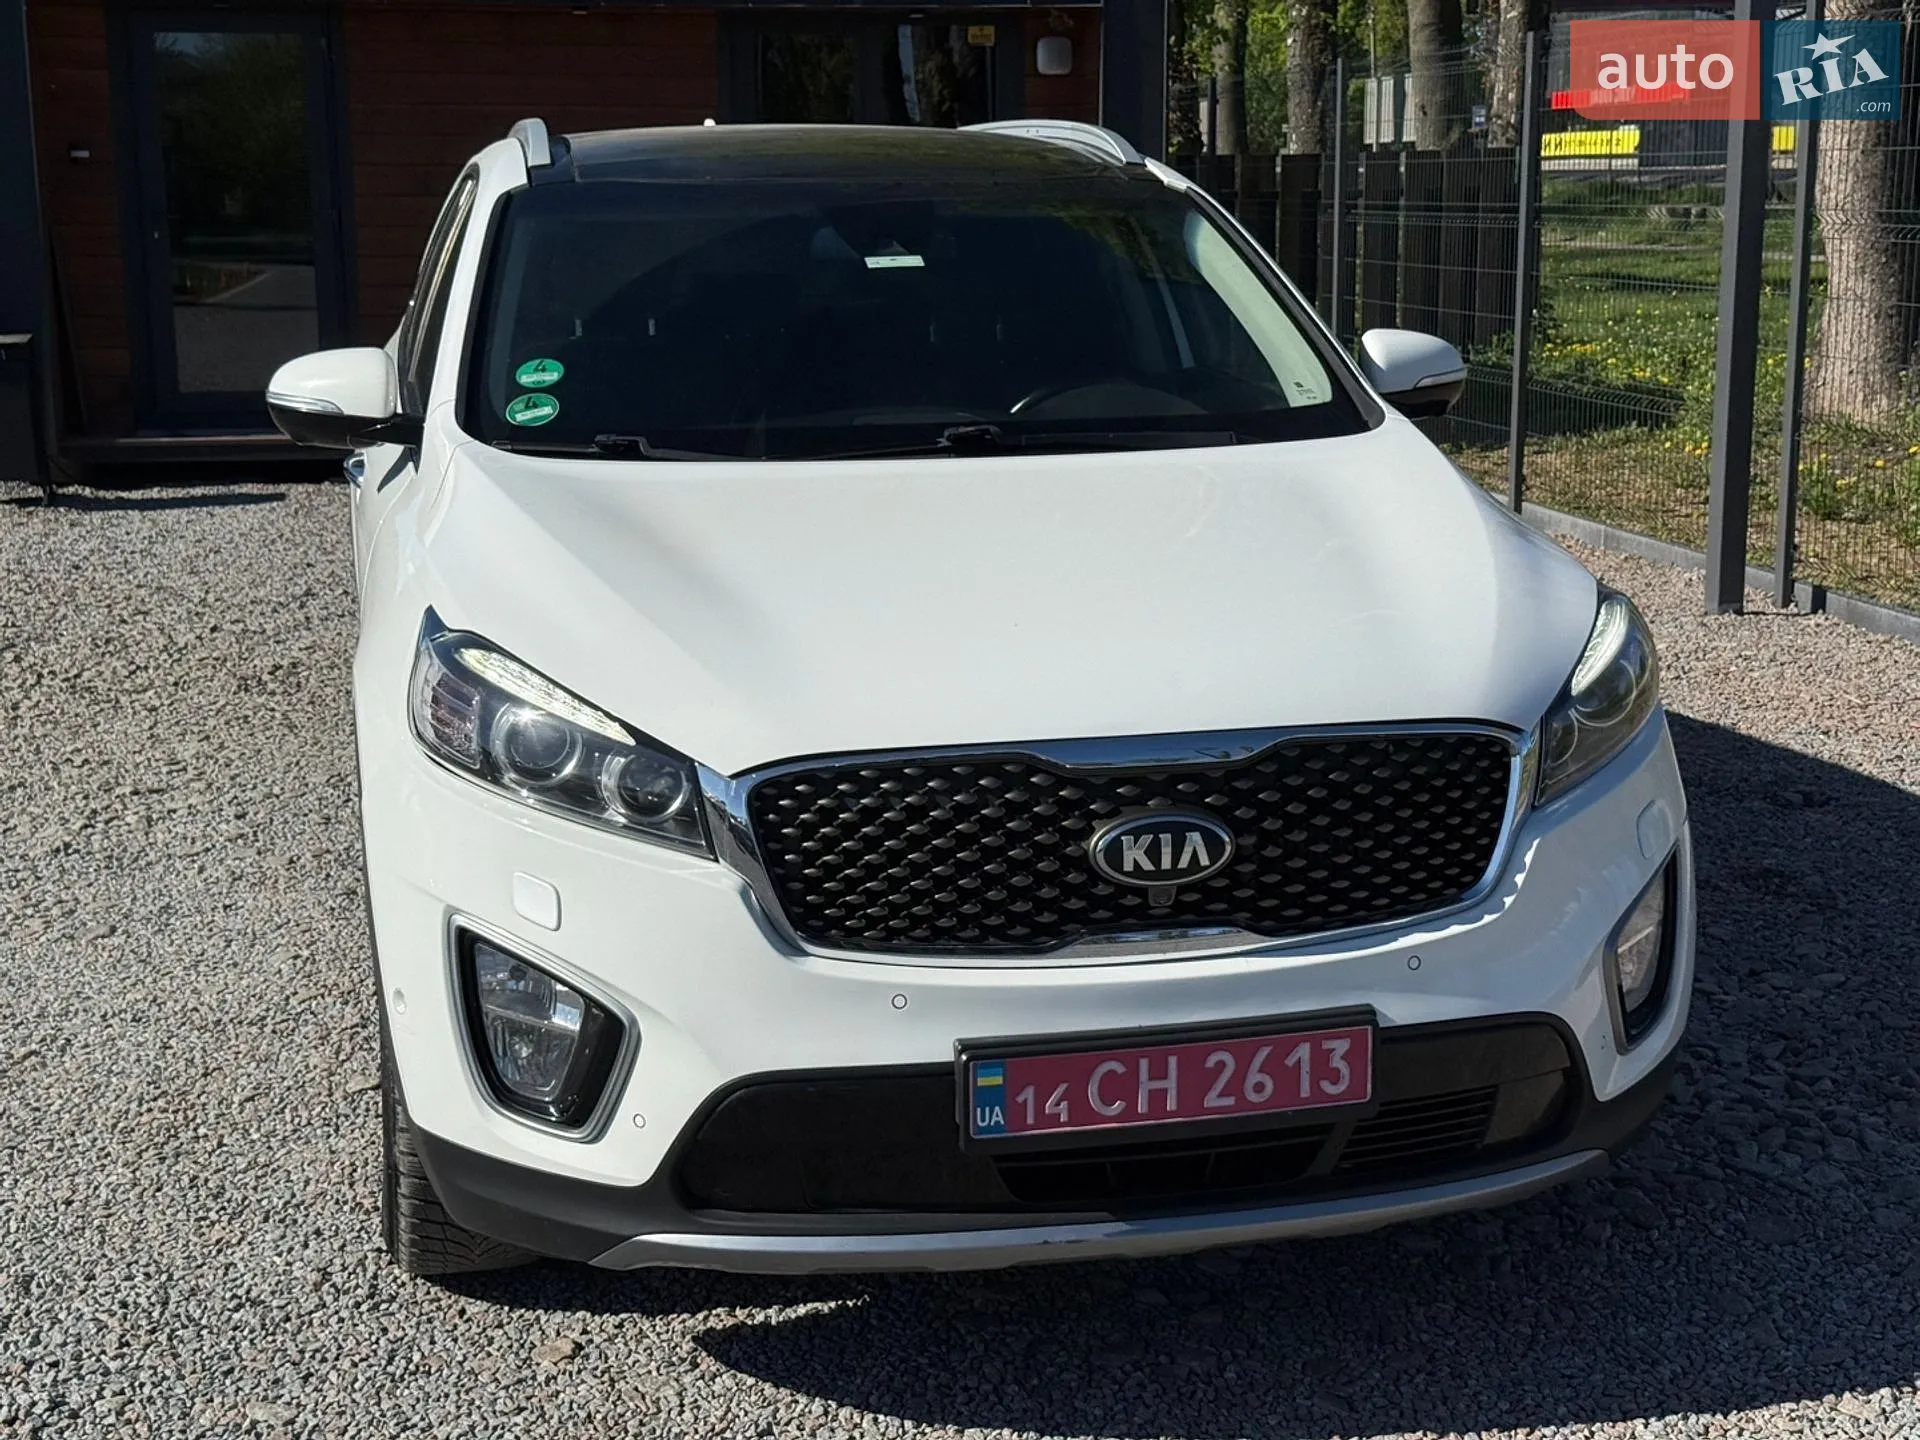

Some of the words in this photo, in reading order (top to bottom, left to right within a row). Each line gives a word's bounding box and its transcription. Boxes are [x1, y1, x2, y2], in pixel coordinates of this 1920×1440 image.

[532, 360, 547, 373] 4
[524, 396, 539, 409] 4
[1120, 831, 1211, 872] KIA
[1015, 1082, 1070, 1125] 14
[1087, 1055, 1178, 1117] CH
[1203, 1037, 1352, 1109] 2613
[976, 1106, 1005, 1127] UA
